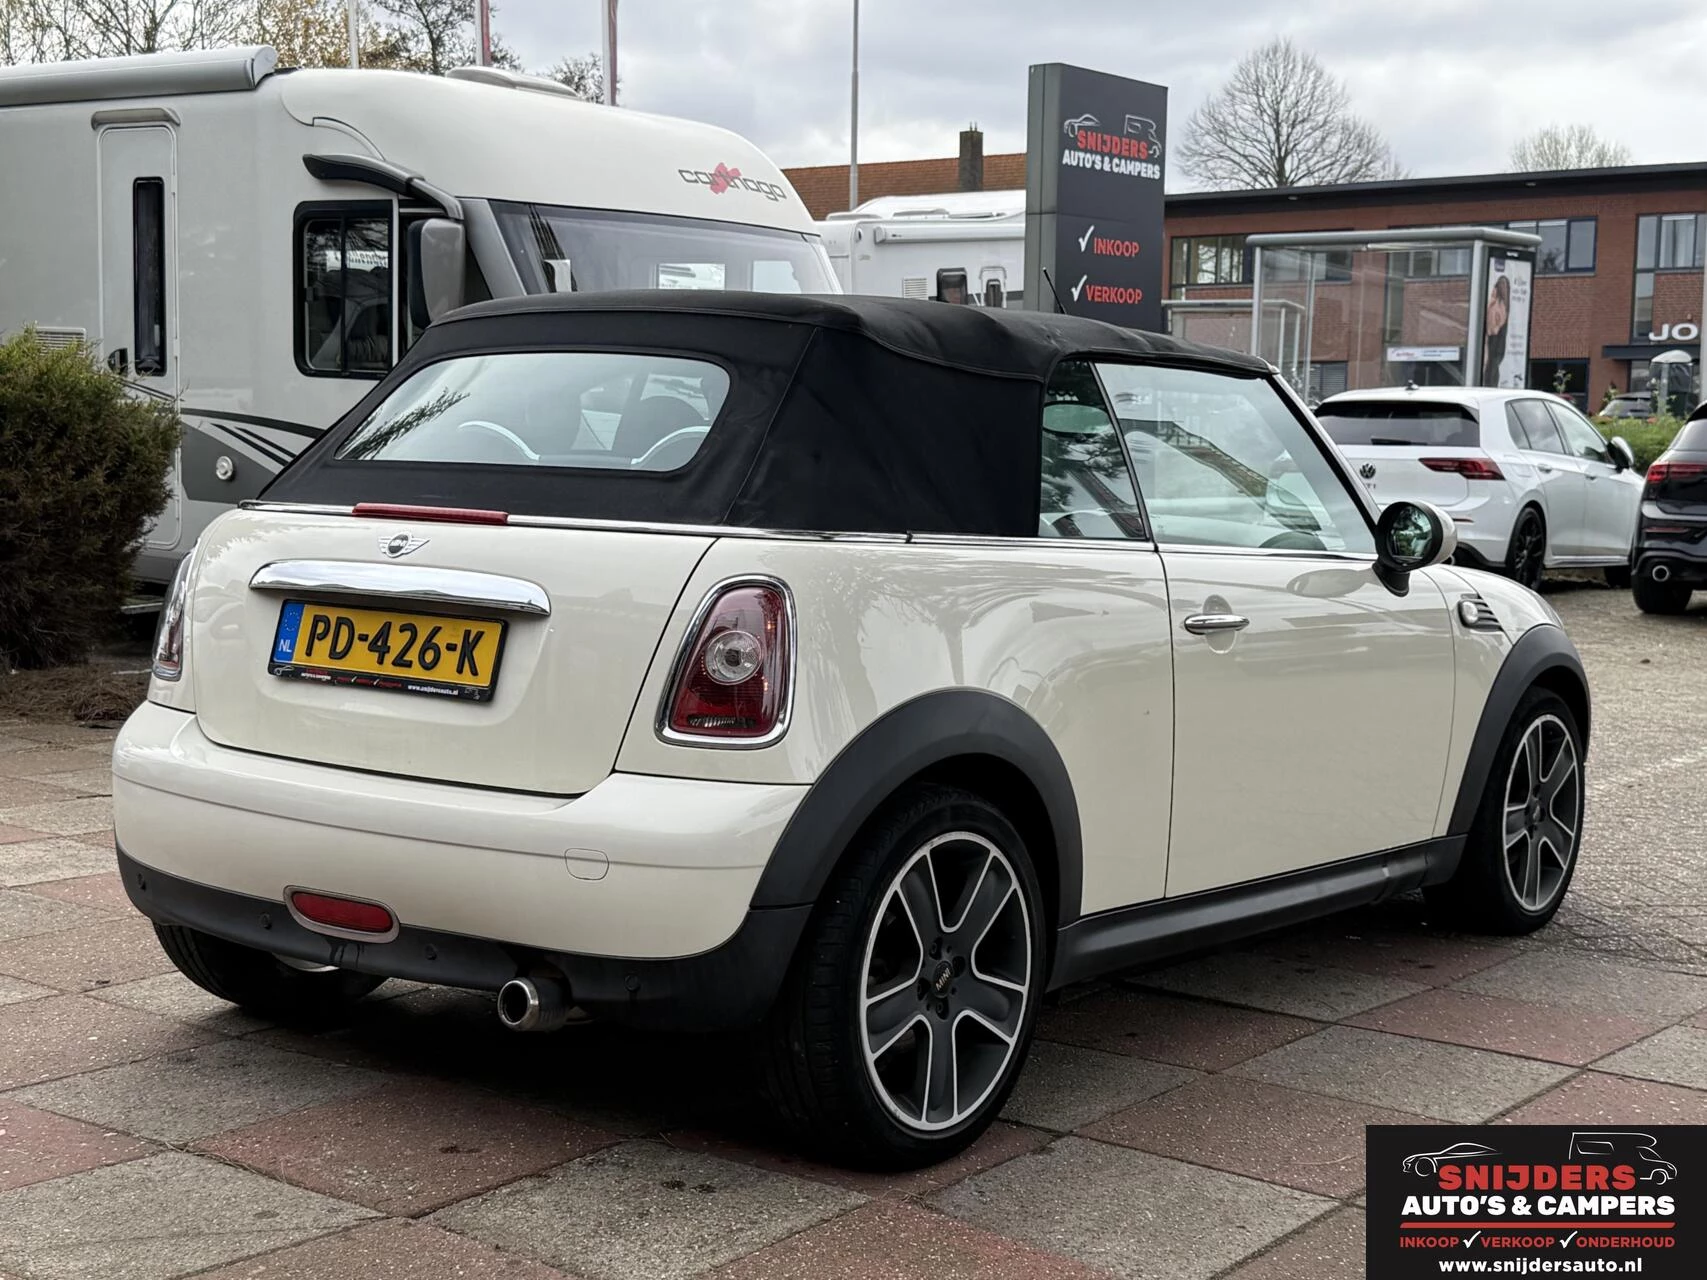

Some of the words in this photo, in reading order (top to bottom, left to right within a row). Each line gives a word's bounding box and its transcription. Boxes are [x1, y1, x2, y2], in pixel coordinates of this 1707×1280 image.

[1077, 129, 1148, 159] SNIJDERS
[1062, 149, 1102, 171] AUTO'S
[1103, 157, 1111, 172] &
[1112, 157, 1161, 180] CAMPERS
[1093, 237, 1140, 258] INKOOP
[1085, 284, 1142, 305] VERKOOP
[278, 639, 293, 653] NL
[305, 614, 485, 677] PD-426-K
